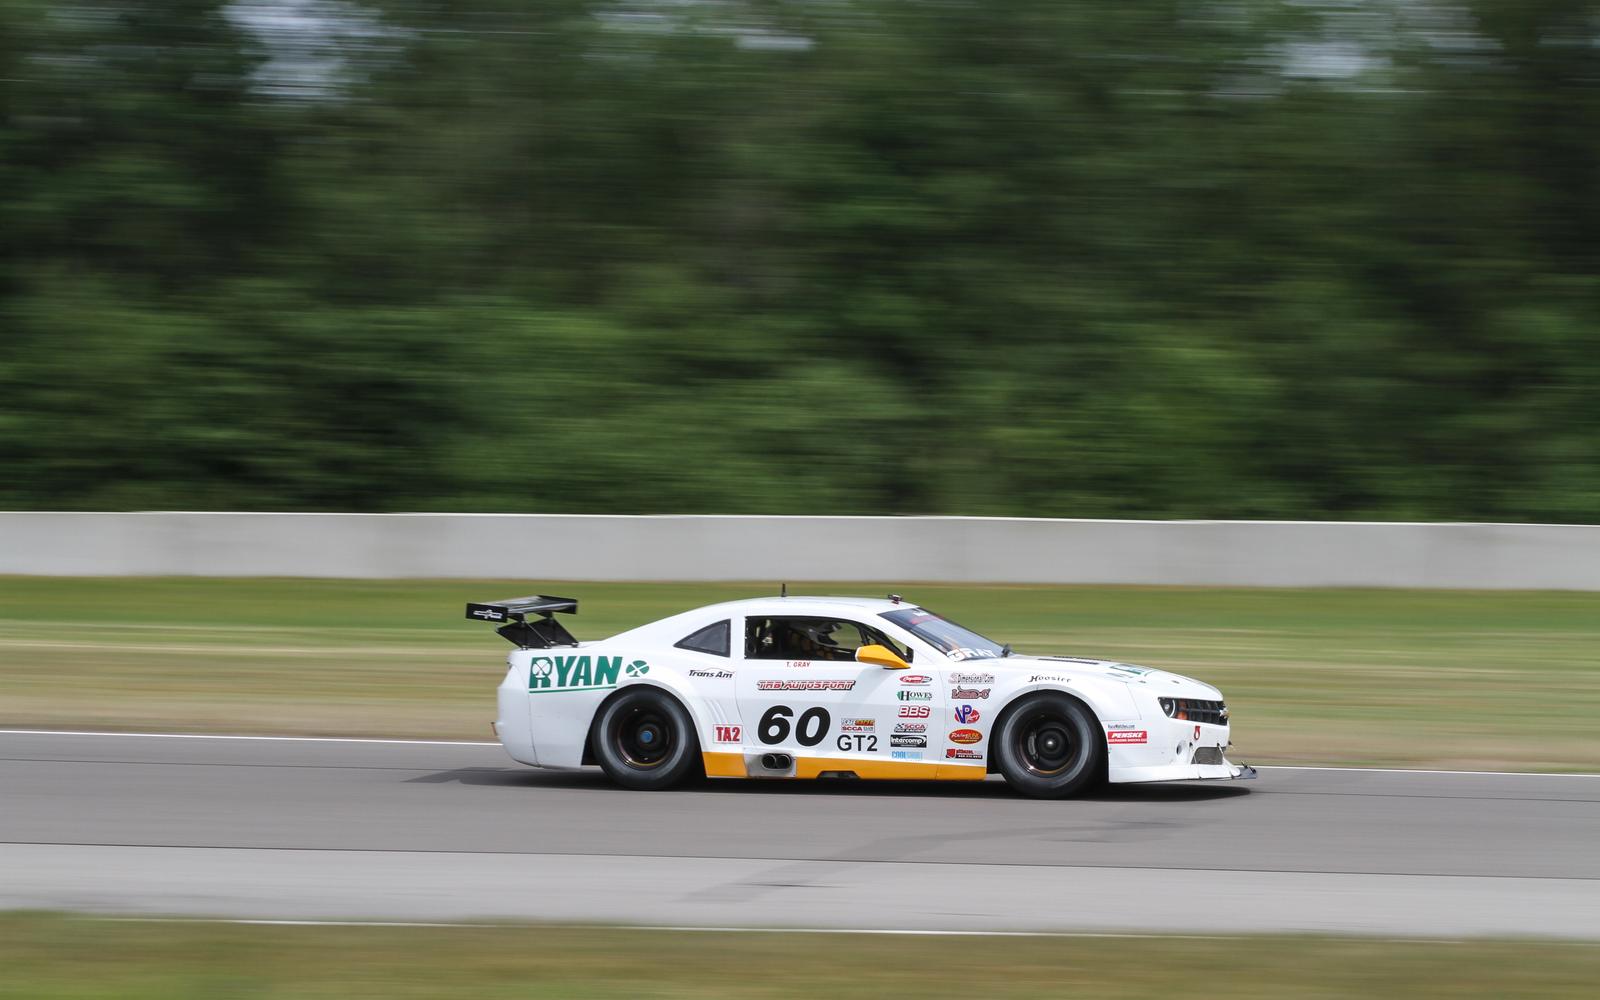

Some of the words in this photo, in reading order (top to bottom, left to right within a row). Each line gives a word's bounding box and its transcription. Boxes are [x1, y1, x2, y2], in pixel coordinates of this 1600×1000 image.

[529, 656, 623, 688] RYAN
[689, 670, 714, 678] Trans
[716, 671, 733, 679] Am
[1028, 674, 1072, 682] Hoosier
[783, 680, 856, 691] AUTOSPORT
[898, 705, 931, 718] BBS
[955, 705, 972, 724] VP
[758, 705, 831, 747] 60
[716, 727, 741, 742] TA2
[890, 736, 923, 745] Intercomp
[837, 735, 878, 751] GT2
